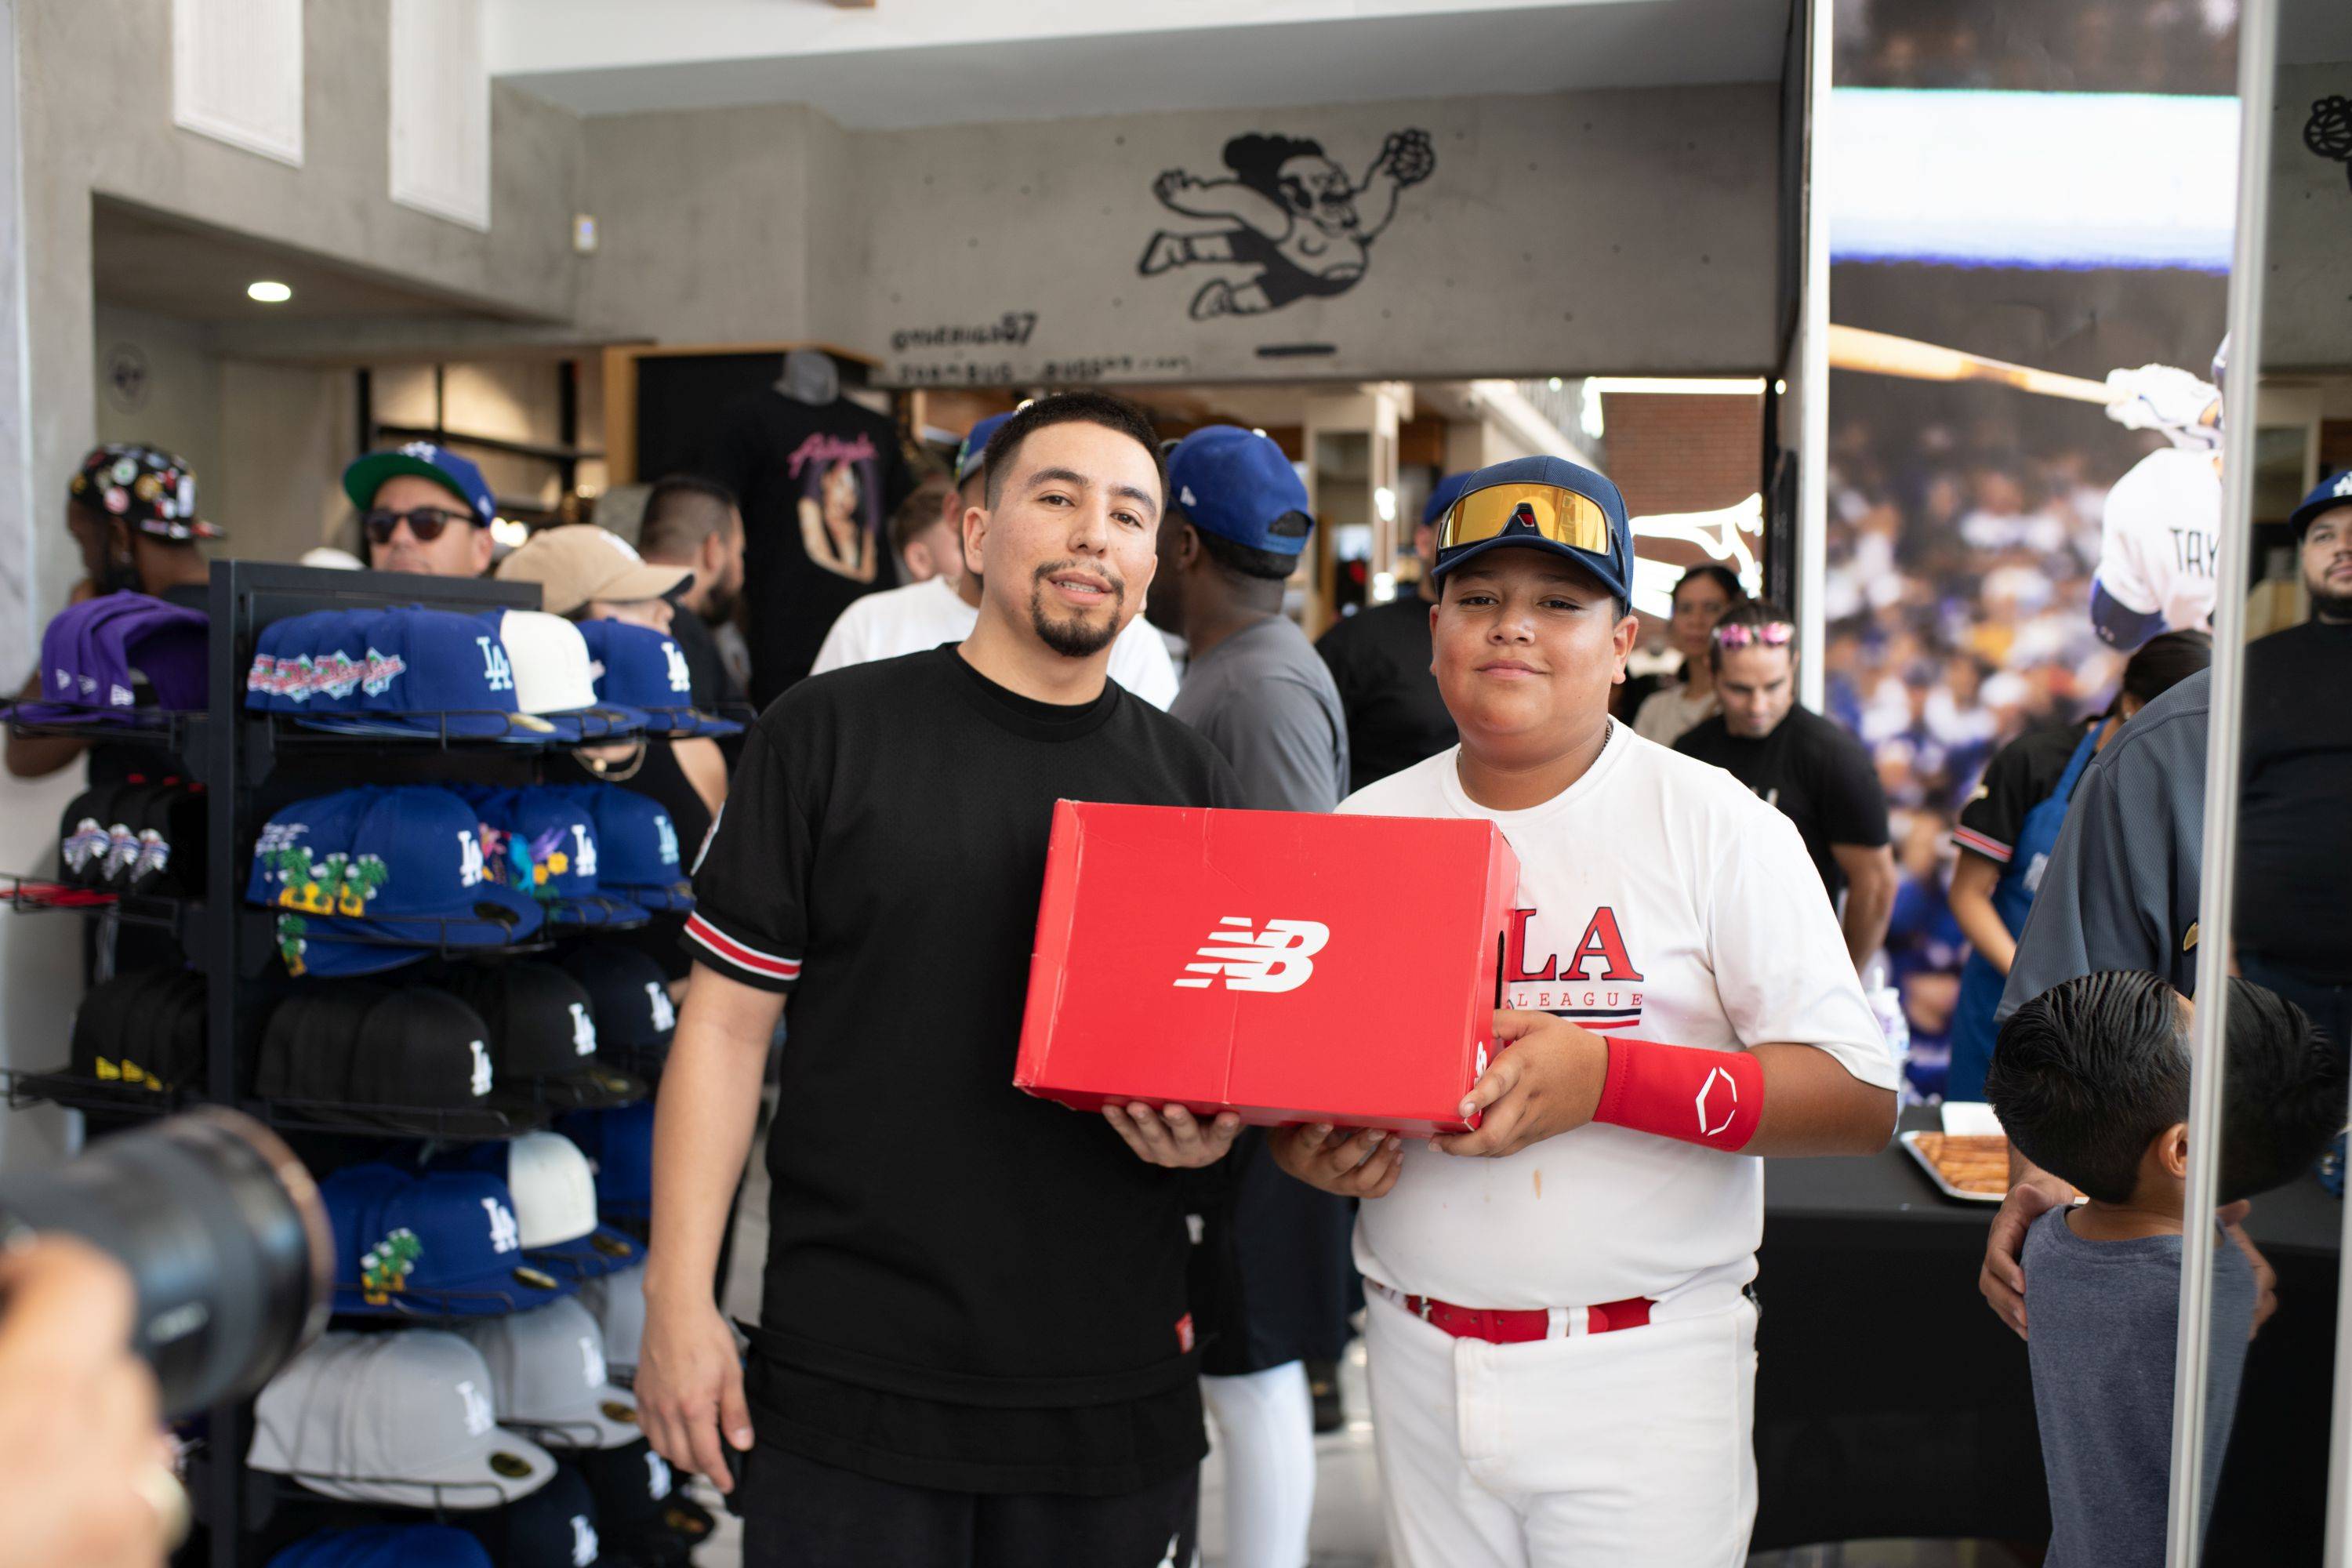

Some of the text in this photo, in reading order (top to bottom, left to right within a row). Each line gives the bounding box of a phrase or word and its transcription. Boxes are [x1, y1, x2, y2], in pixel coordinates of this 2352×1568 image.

[1173, 916, 1330, 993] NB
[1510, 907, 1644, 982] LA
[1517, 993, 1643, 1007] LEAGUE
